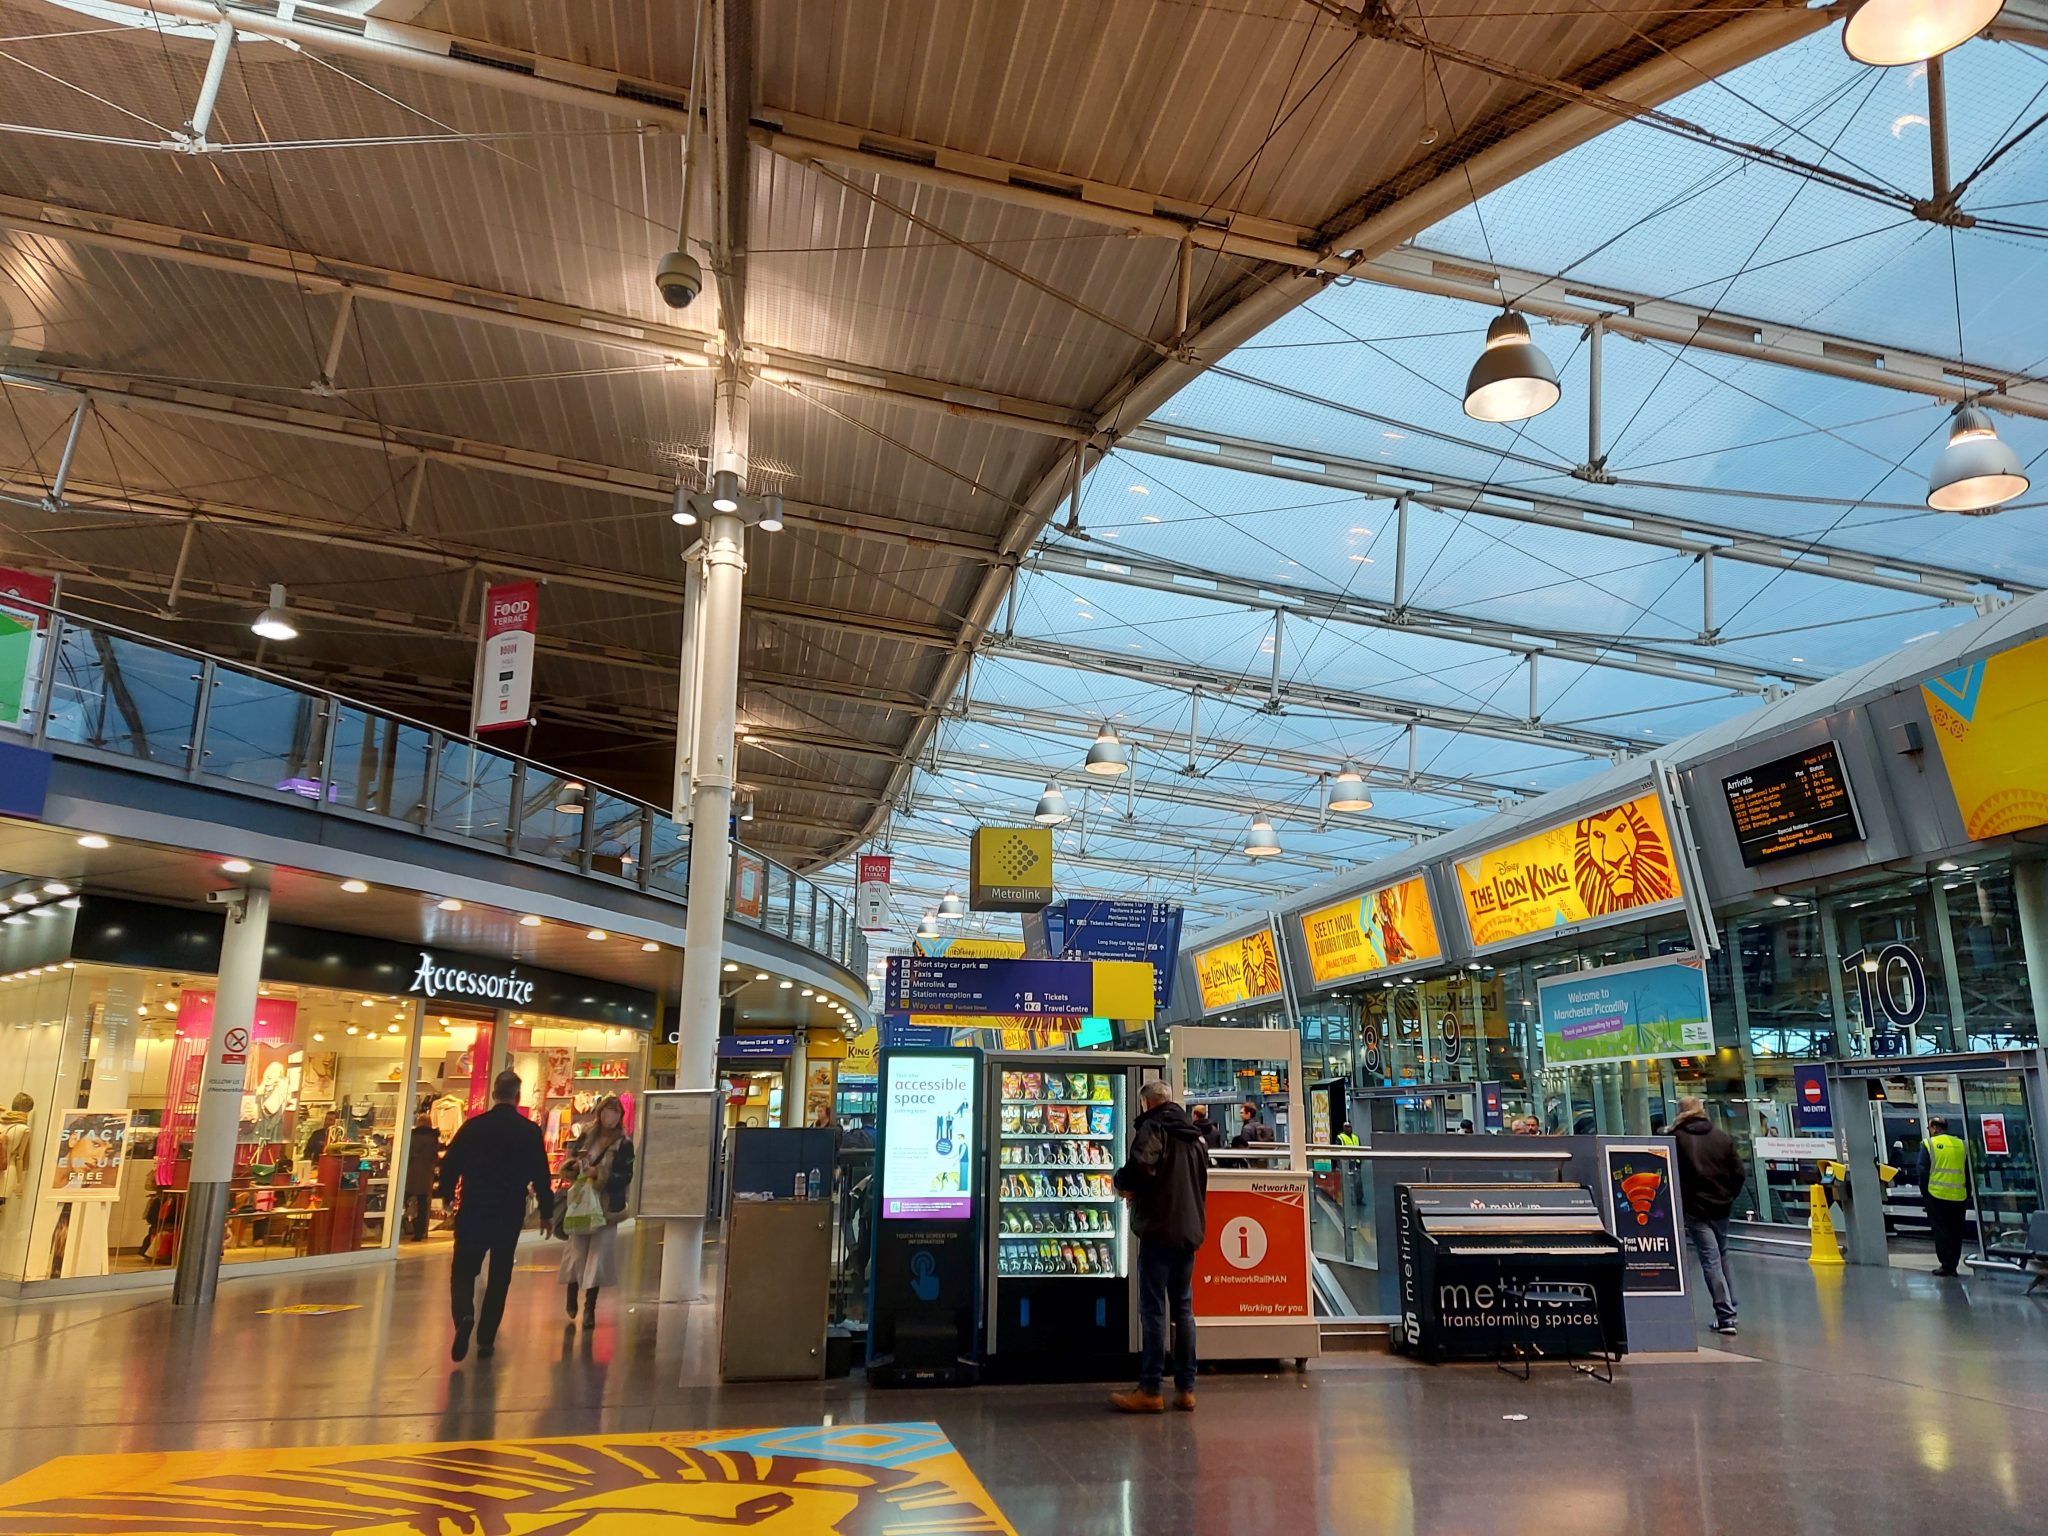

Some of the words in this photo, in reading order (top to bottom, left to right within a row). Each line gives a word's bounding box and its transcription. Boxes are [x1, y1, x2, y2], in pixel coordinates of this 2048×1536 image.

[494, 601, 530, 617] FOOD
[493, 613, 528, 626] TERRACE
[1727, 776, 1753, 791] Arrivals
[1817, 789, 1844, 801] Cancelled
[1761, 841, 1797, 855] Manchester
[1799, 832, 1833, 846] Piccadilly
[1778, 832, 1804, 843] Welcome
[865, 865, 887, 873] FOOD
[1495, 860, 1519, 876] Disney
[1470, 885, 1495, 909] THE
[1492, 875, 1528, 911] LION
[1525, 862, 1569, 902] KING
[991, 887, 1041, 900] Metrolink
[1313, 921, 1328, 940] SEE
[1327, 918, 1336, 936] IT
[1335, 913, 1356, 932] NOW.
[913, 960, 932, 968] Short
[933, 961, 948, 970] stay
[961, 960, 977, 970] park
[409, 952, 534, 1005] Accessorize
[1202, 971, 1213, 988] THE
[1211, 967, 1226, 988] LION
[1223, 961, 1241, 985] KING
[912, 980, 945, 988] Metrolink
[1842, 943, 1927, 1030] 10
[912, 990, 937, 998] Station
[938, 990, 971, 1000] reception
[1044, 993, 1068, 1001] Tickets
[1568, 990, 1600, 1003] Welcome
[1601, 989, 1609, 998] to
[913, 1002, 928, 1010] Way
[1044, 1004, 1065, 1012] Travel
[1066, 1004, 1089, 1013] Centre
[1554, 1005, 1594, 1020] Manchester
[1594, 1000, 1629, 1015] Piccadilly
[1442, 1011, 1461, 1065] 9
[1363, 1024, 1380, 1072] 8
[1873, 1040, 1880, 1050] 9
[1888, 1039, 1895, 1050] 9
[848, 1046, 870, 1058] KING
[895, 1078, 967, 1091] accessible
[894, 1094, 935, 1107] space
[1002, 1109, 1020, 1119] MAX
[60, 1129, 126, 1141] STACK
[97, 1157, 122, 1168] UP
[69, 1172, 104, 1180] FREE
[1251, 1183, 1306, 1192] NetworkRail
[1623, 1236, 1637, 1245] Fast
[1637, 1236, 1669, 1252] WiFi
[1400, 1193, 1414, 1302] metirium
[1624, 1244, 1638, 1252] Free
[1214, 1275, 1287, 1284] @NetworkRailMAN
[1239, 1304, 1273, 1314] Working
[1274, 1303, 1287, 1312] for
[1288, 1304, 1304, 1314] you.
[1442, 1312, 1541, 1329] transforming
[1545, 1312, 1600, 1329] spaces
